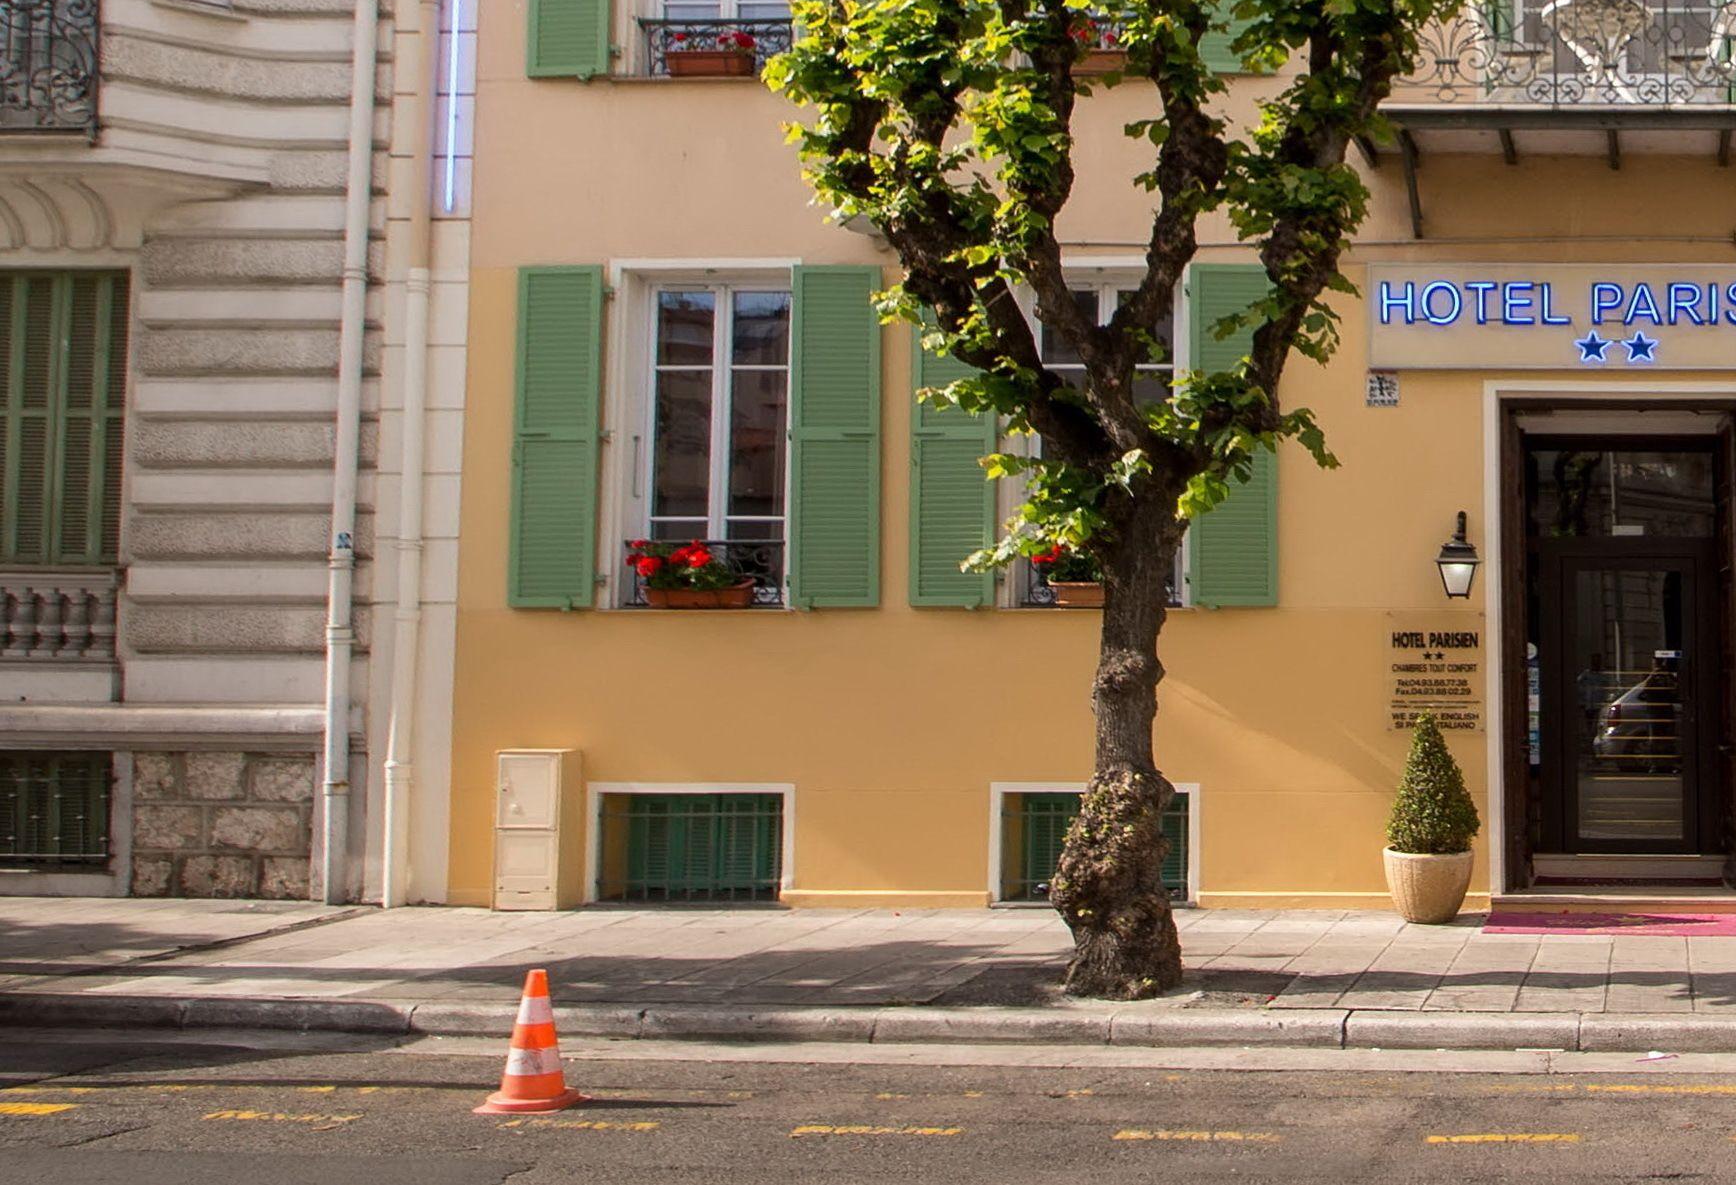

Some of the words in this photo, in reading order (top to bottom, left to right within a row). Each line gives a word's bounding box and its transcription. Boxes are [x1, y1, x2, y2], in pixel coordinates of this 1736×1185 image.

[1380, 280, 1571, 325] HOTEL
[1392, 632, 1426, 648] HOTEL
[1429, 632, 1478, 648] PARISIEN
[1392, 664, 1427, 672] CHAMBRES
[1430, 664, 1445, 672] TOUT
[1447, 664, 1477, 672] CONFORT
